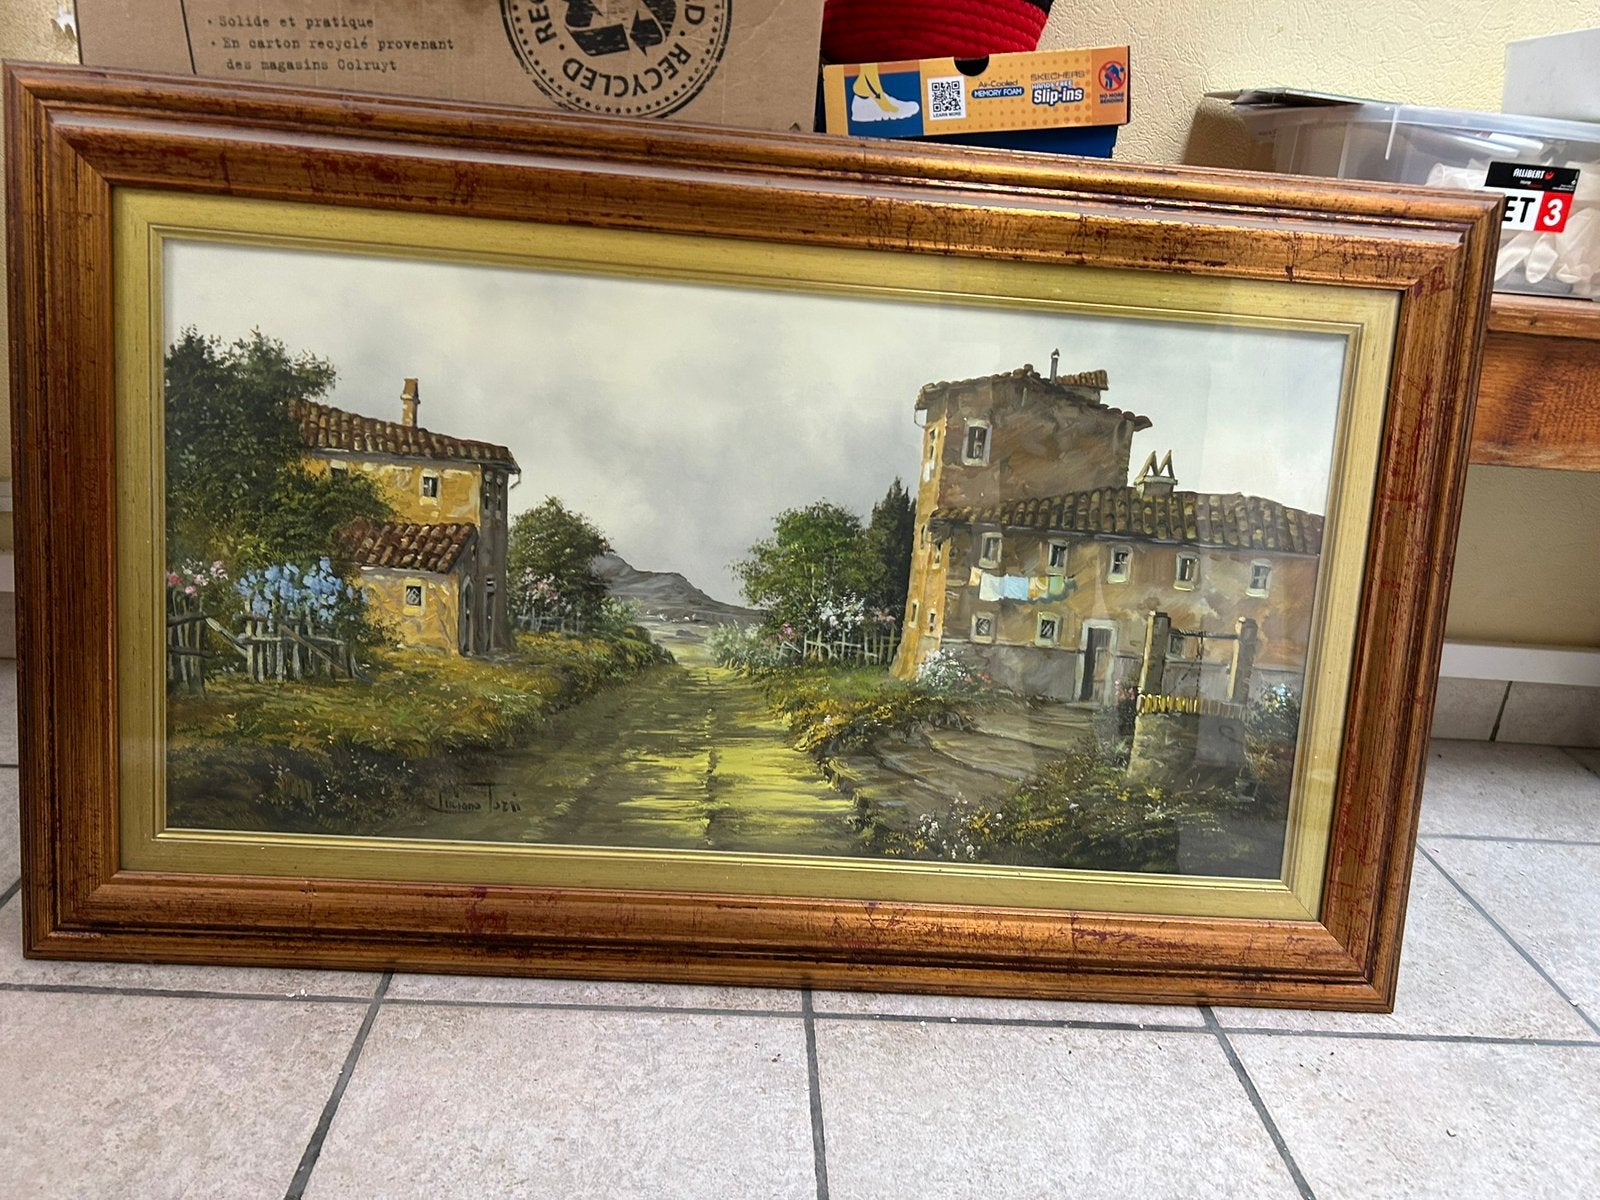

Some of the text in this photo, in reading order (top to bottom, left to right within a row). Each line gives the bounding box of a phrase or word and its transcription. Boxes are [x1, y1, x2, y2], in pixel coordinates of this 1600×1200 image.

[219, 15, 374, 30] Solide et pratique
[222, 36, 454, 51] En carton recyclé provenant
[226, 58, 397, 73] des magasins Colruyt
[562, 43, 692, 97] RECYCLED
[1030, 70, 1085, 81] SKECHERS
[978, 80, 1018, 88] Air-Cooled
[974, 87, 1022, 98] MEMORY FOAM
[1033, 87, 1084, 106] Slip-ins
[1543, 198, 1563, 227] 3
